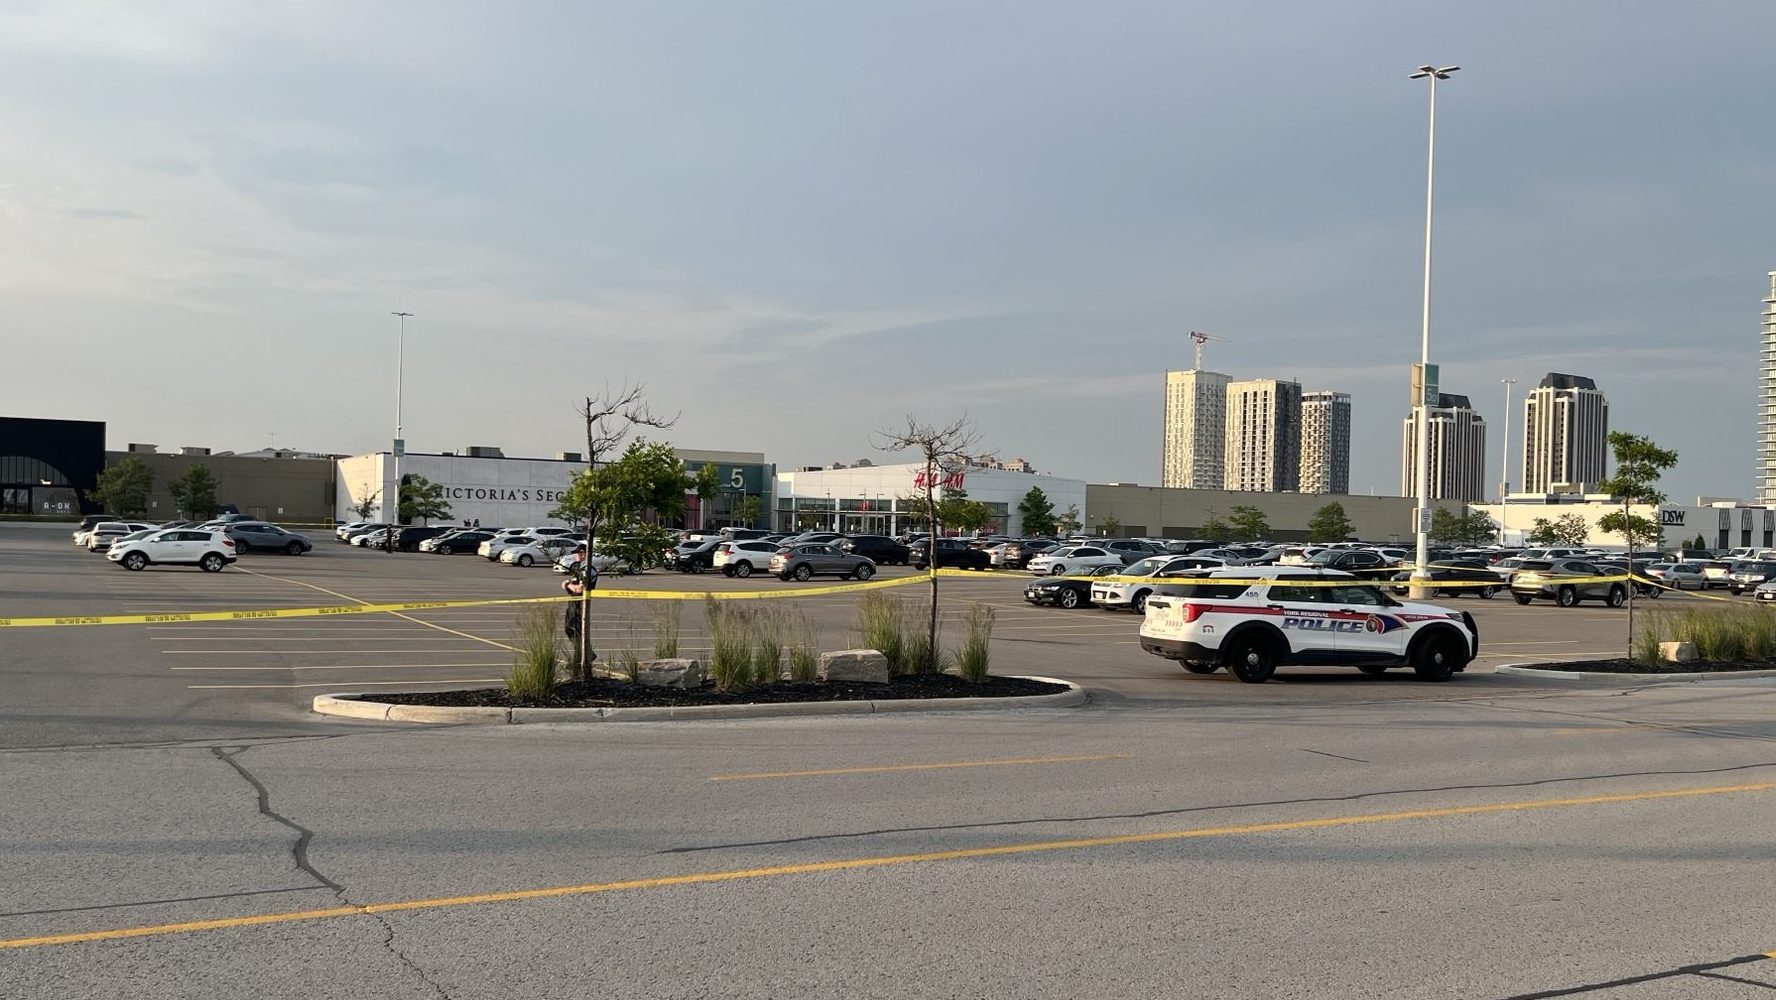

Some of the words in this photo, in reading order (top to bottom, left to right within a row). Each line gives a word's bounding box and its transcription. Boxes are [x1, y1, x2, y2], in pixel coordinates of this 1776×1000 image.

[731, 468, 744, 488] 5
[438, 487, 529, 501] ICTORIA'S
[1662, 509, 1685, 523] DSW
[1281, 617, 1365, 633] POLICE
